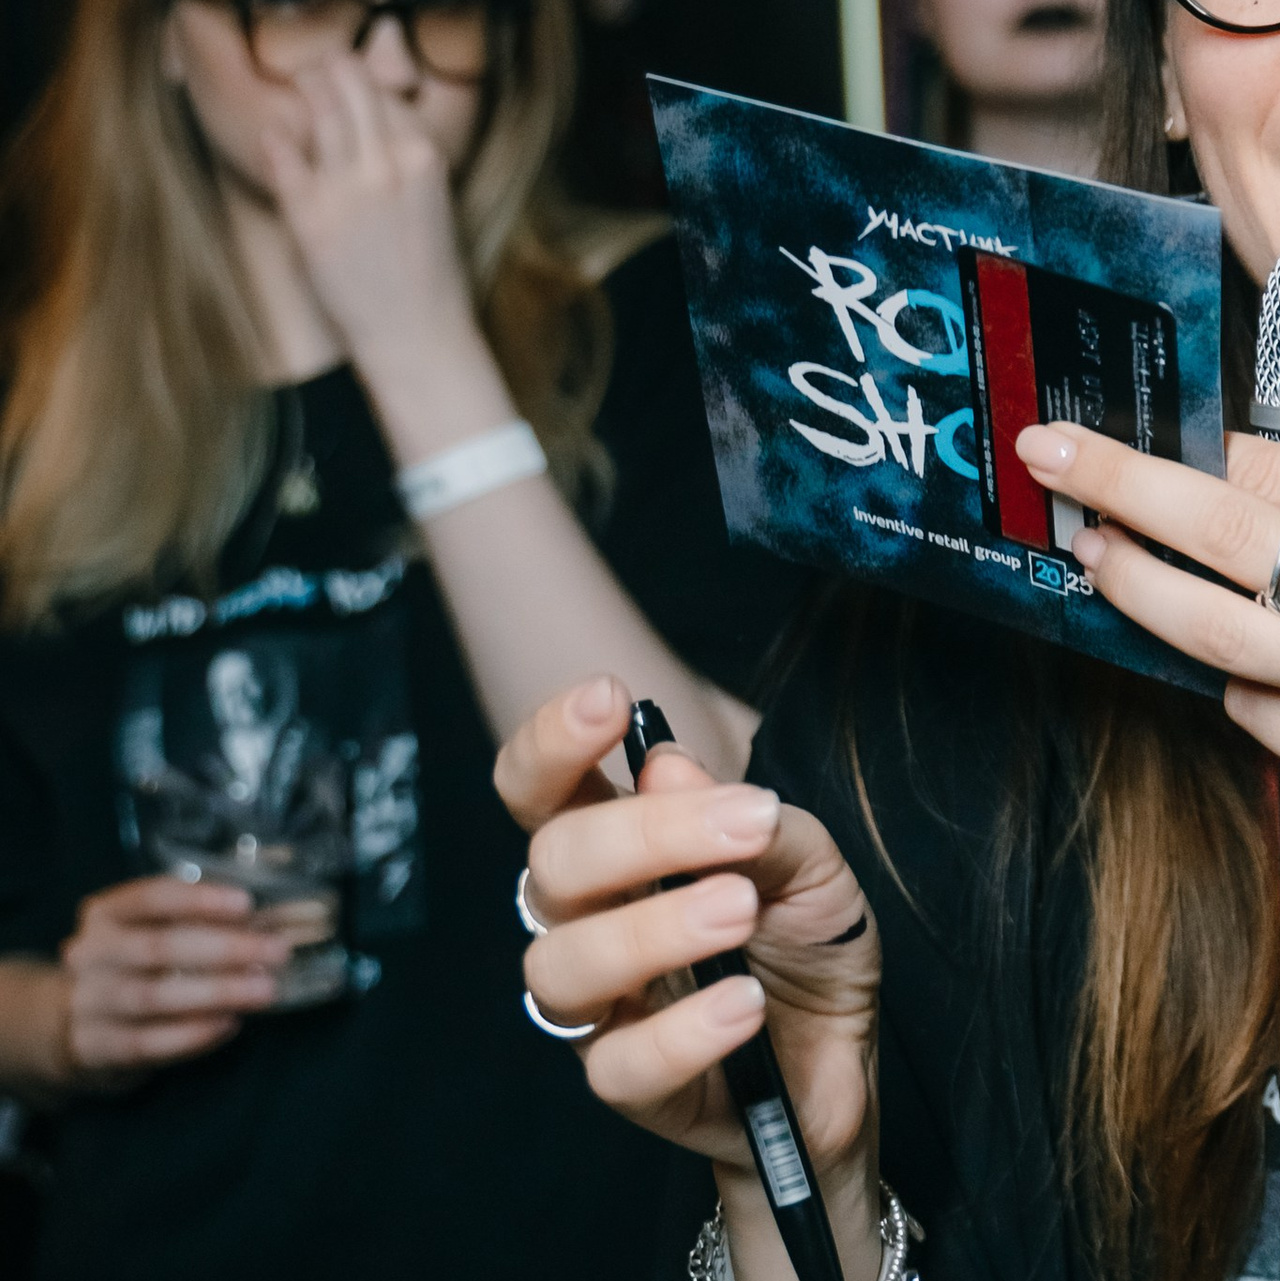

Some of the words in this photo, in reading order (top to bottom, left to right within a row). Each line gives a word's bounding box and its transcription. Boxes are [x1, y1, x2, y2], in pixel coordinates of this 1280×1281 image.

[853, 506, 924, 540] inventive
[928, 531, 970, 554] retail
[974, 545, 1021, 571] group
